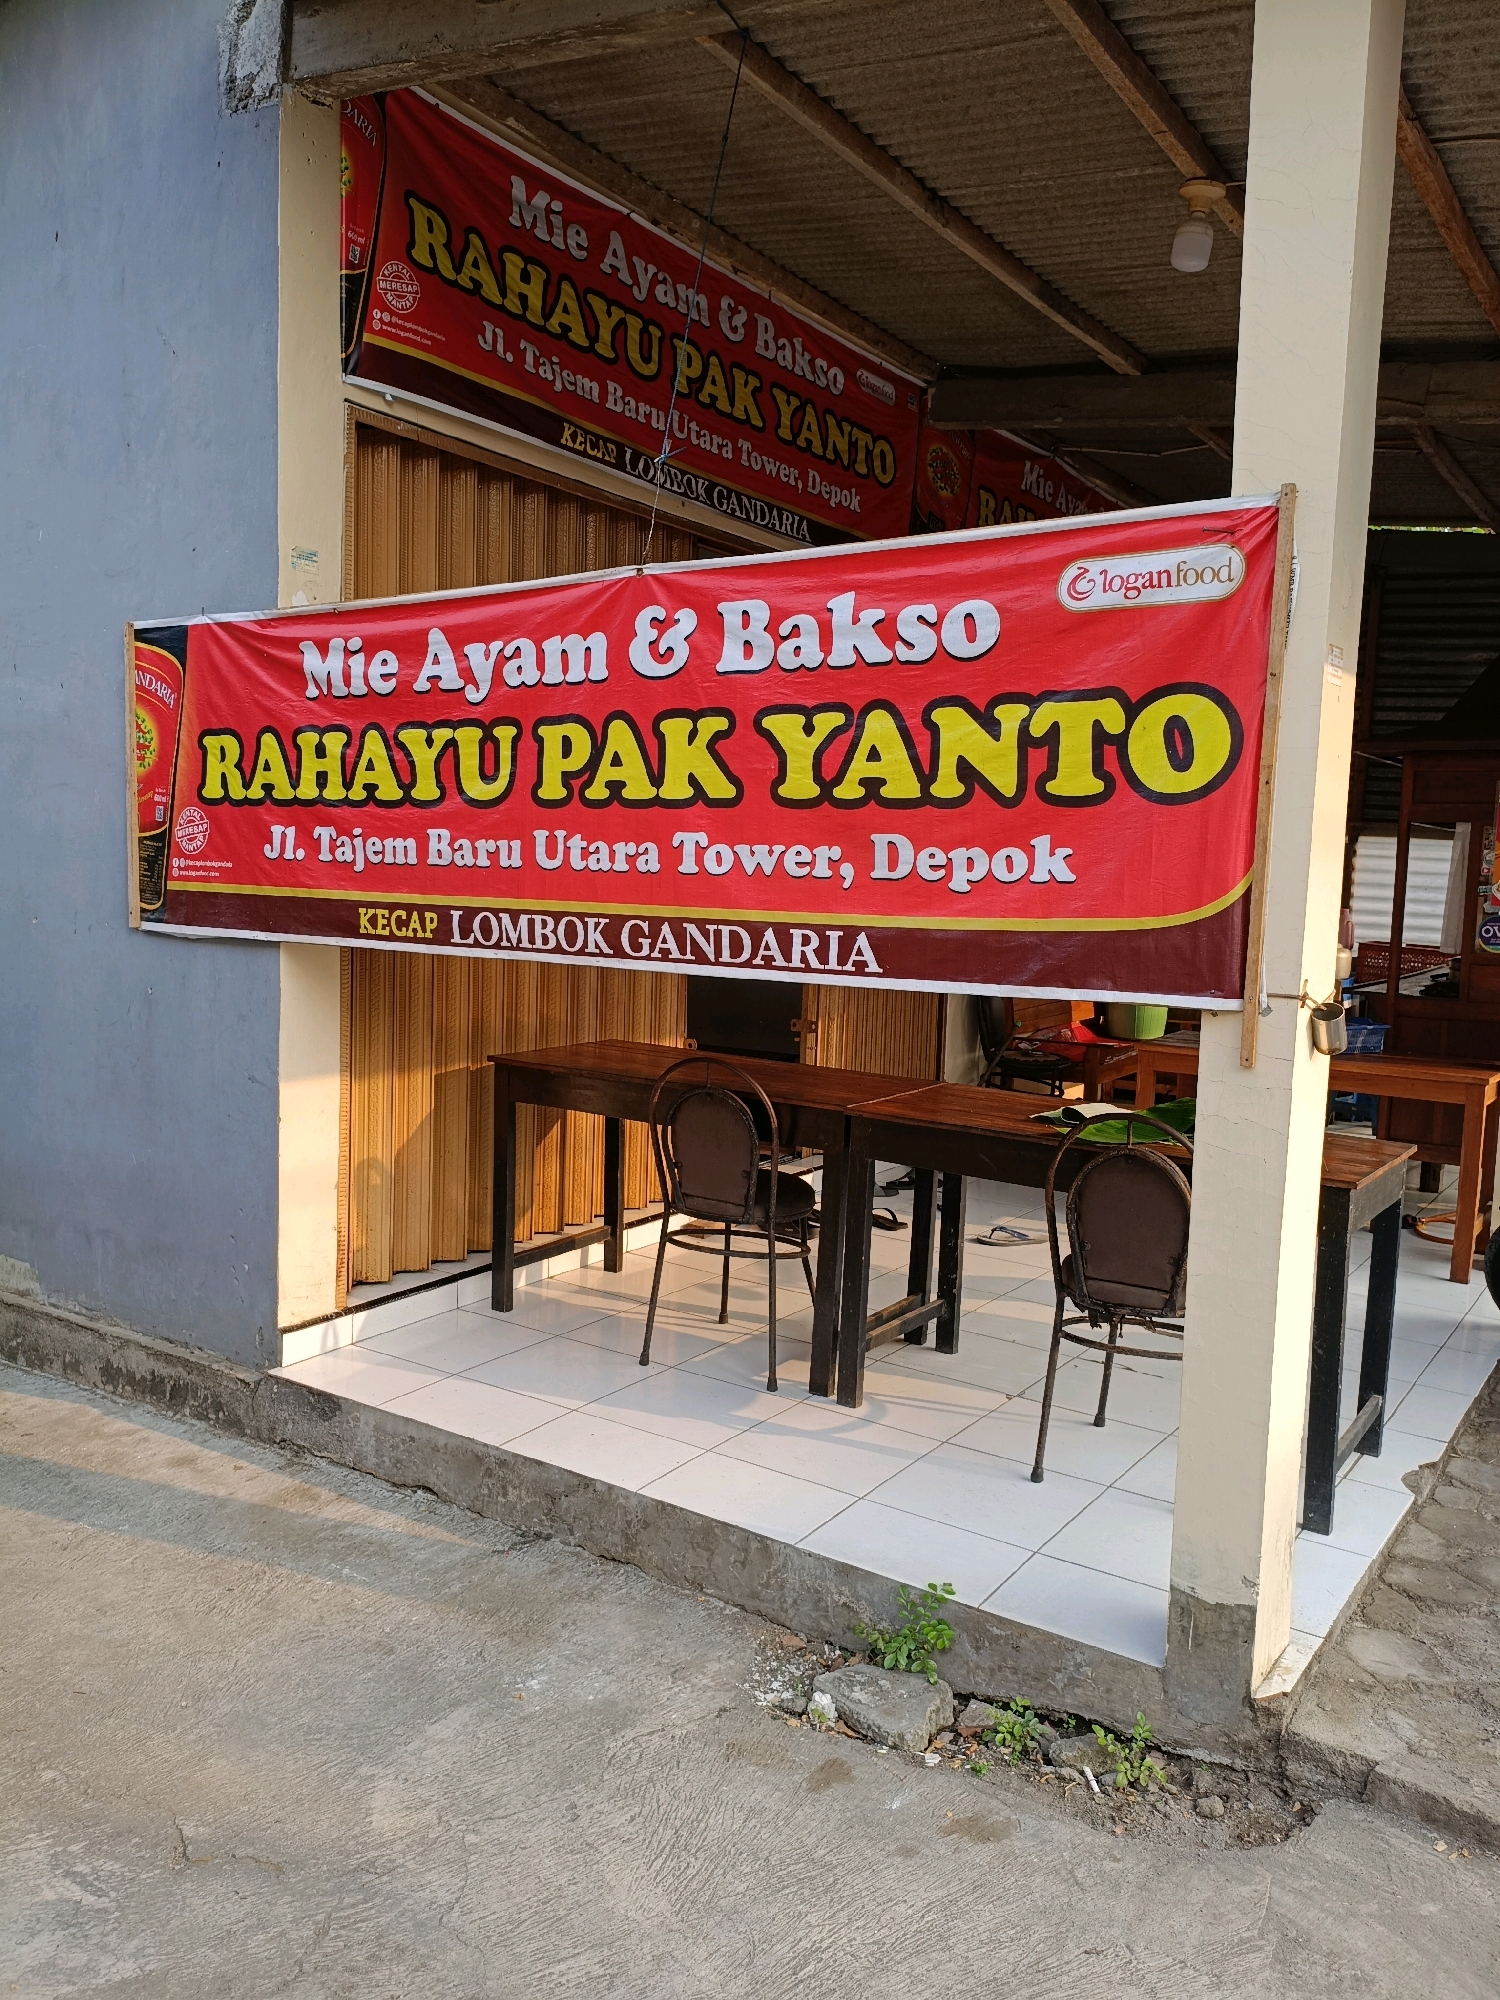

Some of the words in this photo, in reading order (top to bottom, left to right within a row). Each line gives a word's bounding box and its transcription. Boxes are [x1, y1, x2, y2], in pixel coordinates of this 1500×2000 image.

[380, 280, 418, 293] MERESAP
[383, 264, 412, 280] KENTAL
[386, 292, 414, 309] MANTAP
[509, 175, 589, 261] Mie
[600, 231, 709, 326] Ayam
[718, 294, 750, 342] &
[754, 314, 845, 397] Bakso
[404, 192, 665, 382] RAHAYU
[671, 332, 765, 431] PAK
[772, 381, 898, 488] YANTO
[477, 320, 514, 364] Jl.
[519, 340, 600, 406] Tajem
[607, 380, 667, 431] Baru
[671, 411, 734, 461] Utara
[737, 437, 804, 495] Tower,
[806, 467, 861, 514] Depok
[560, 421, 618, 464] KECAP
[624, 446, 711, 504] LOMBOK
[713, 481, 813, 543] GANDARIA
[1021, 460, 1053, 503] Mie
[1100, 554, 1240, 602] loganfood
[300, 637, 396, 699] Mie
[412, 627, 609, 702] Ayam
[629, 604, 698, 679] &
[716, 590, 1000, 673] Bakso
[198, 718, 522, 807] RAHAYU
[533, 710, 741, 807] PAK
[755, 684, 1243, 809] YANTO
[177, 823, 208, 838] MERESAP
[180, 809, 202, 826] KENTAL
[181, 835, 205, 852] MANTAP
[264, 825, 304, 861] Jl.
[313, 826, 418, 872] Tajem
[427, 828, 523, 869] Baru
[535, 829, 660, 873] Utara
[672, 832, 855, 889] Tower,
[870, 833, 1077, 893] Depok
[358, 907, 439, 940] KECAP
[450, 910, 613, 956] LOMBOK
[621, 921, 883, 974] GANDARIA
